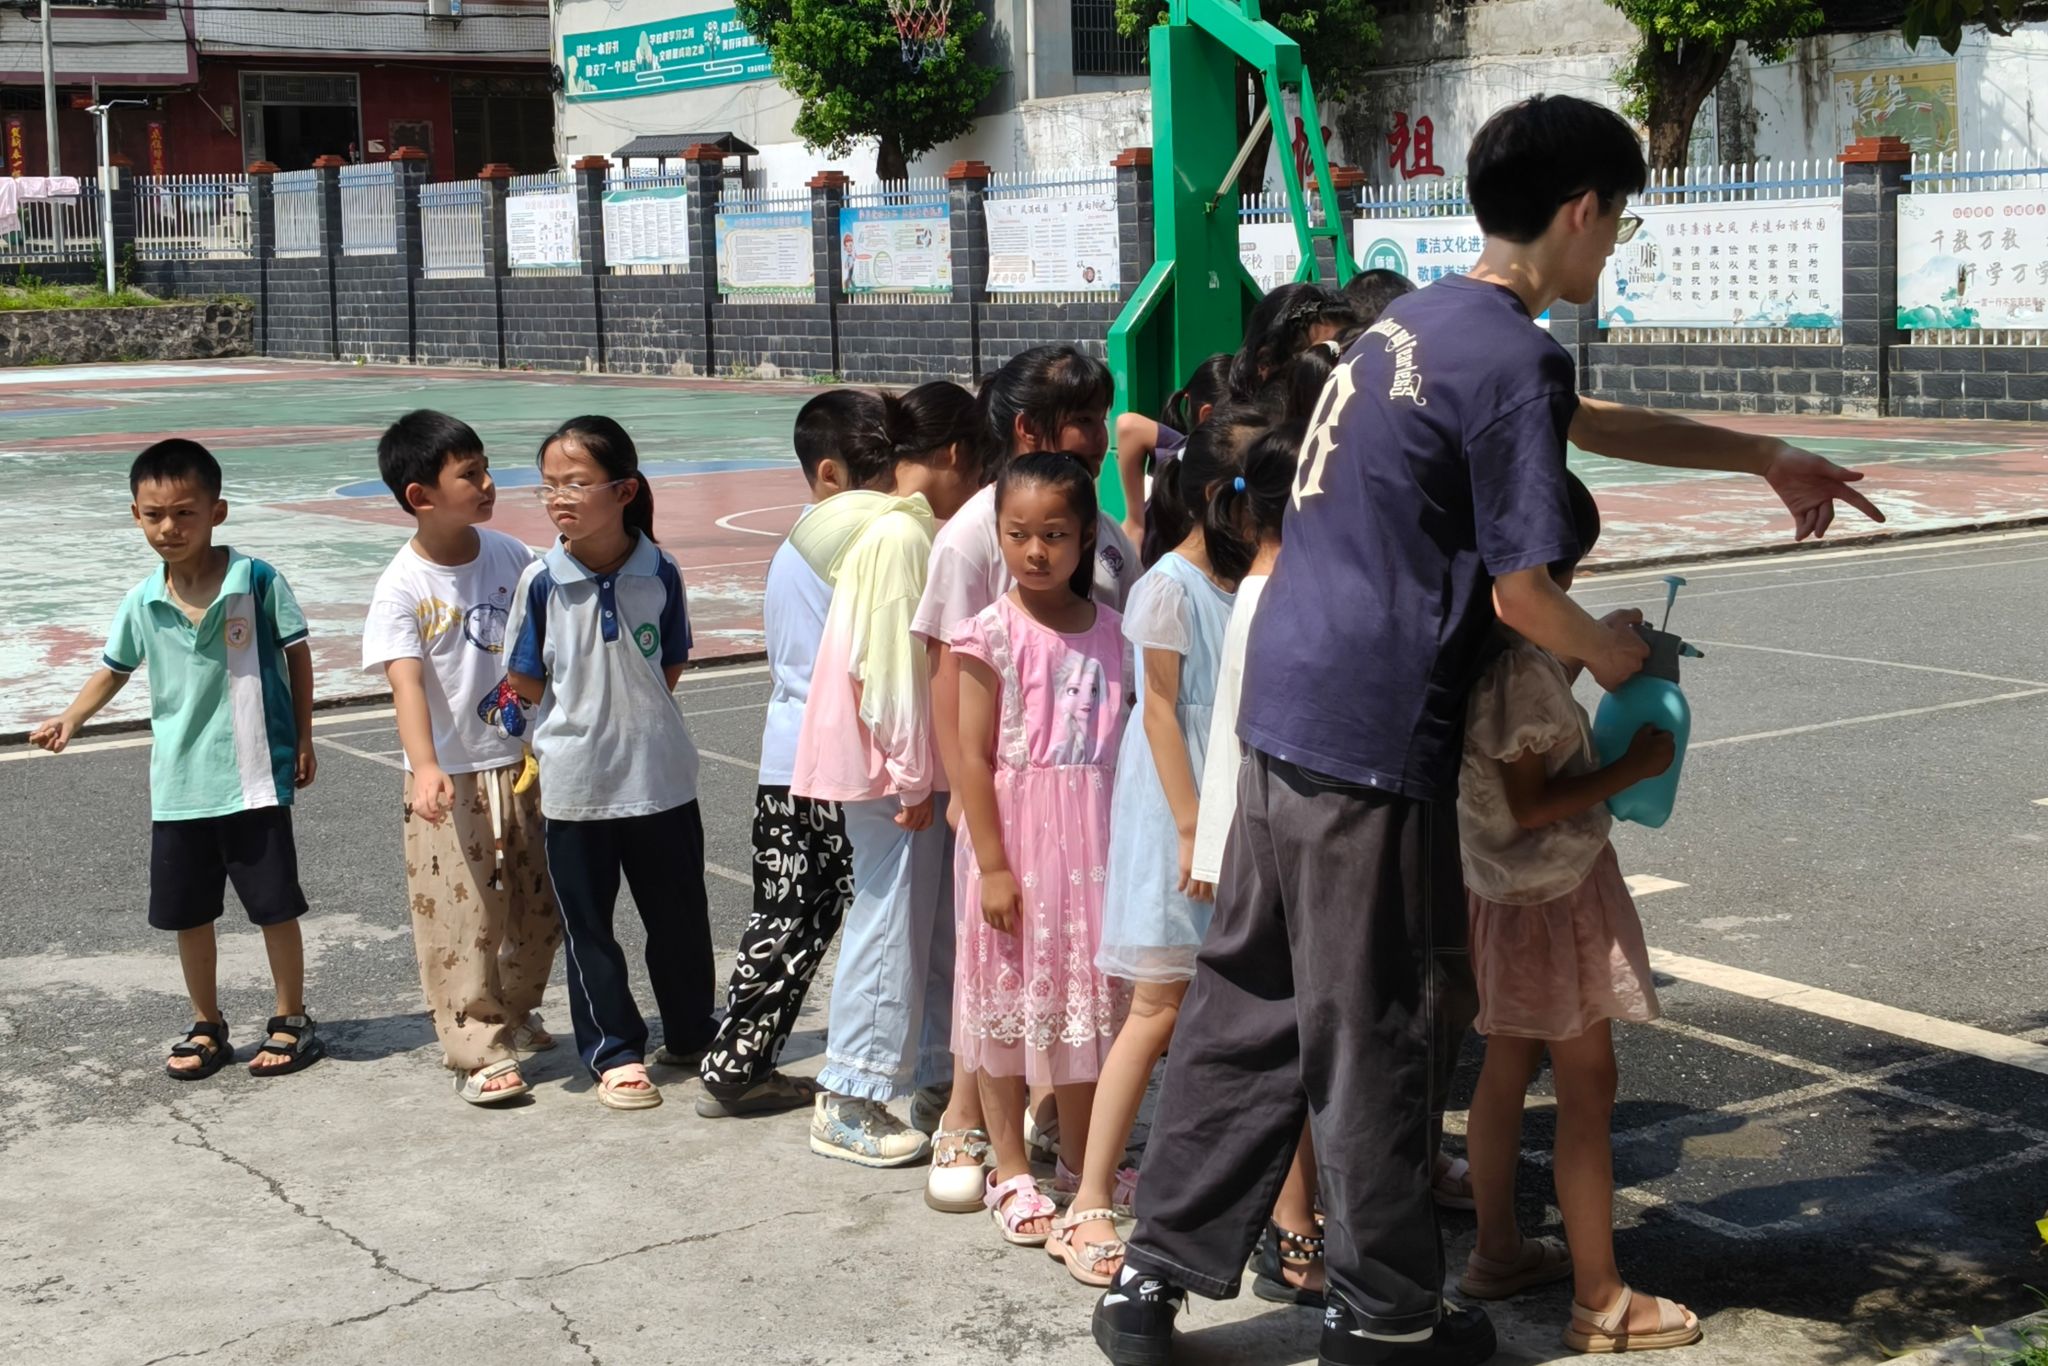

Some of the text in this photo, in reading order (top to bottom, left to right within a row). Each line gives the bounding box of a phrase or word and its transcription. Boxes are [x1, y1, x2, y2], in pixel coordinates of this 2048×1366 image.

[1416, 235, 1488, 253] 廉洁文化进
[1640, 242, 1657, 268] 廉
[1417, 264, 1480, 283] 敬廉崇洁
